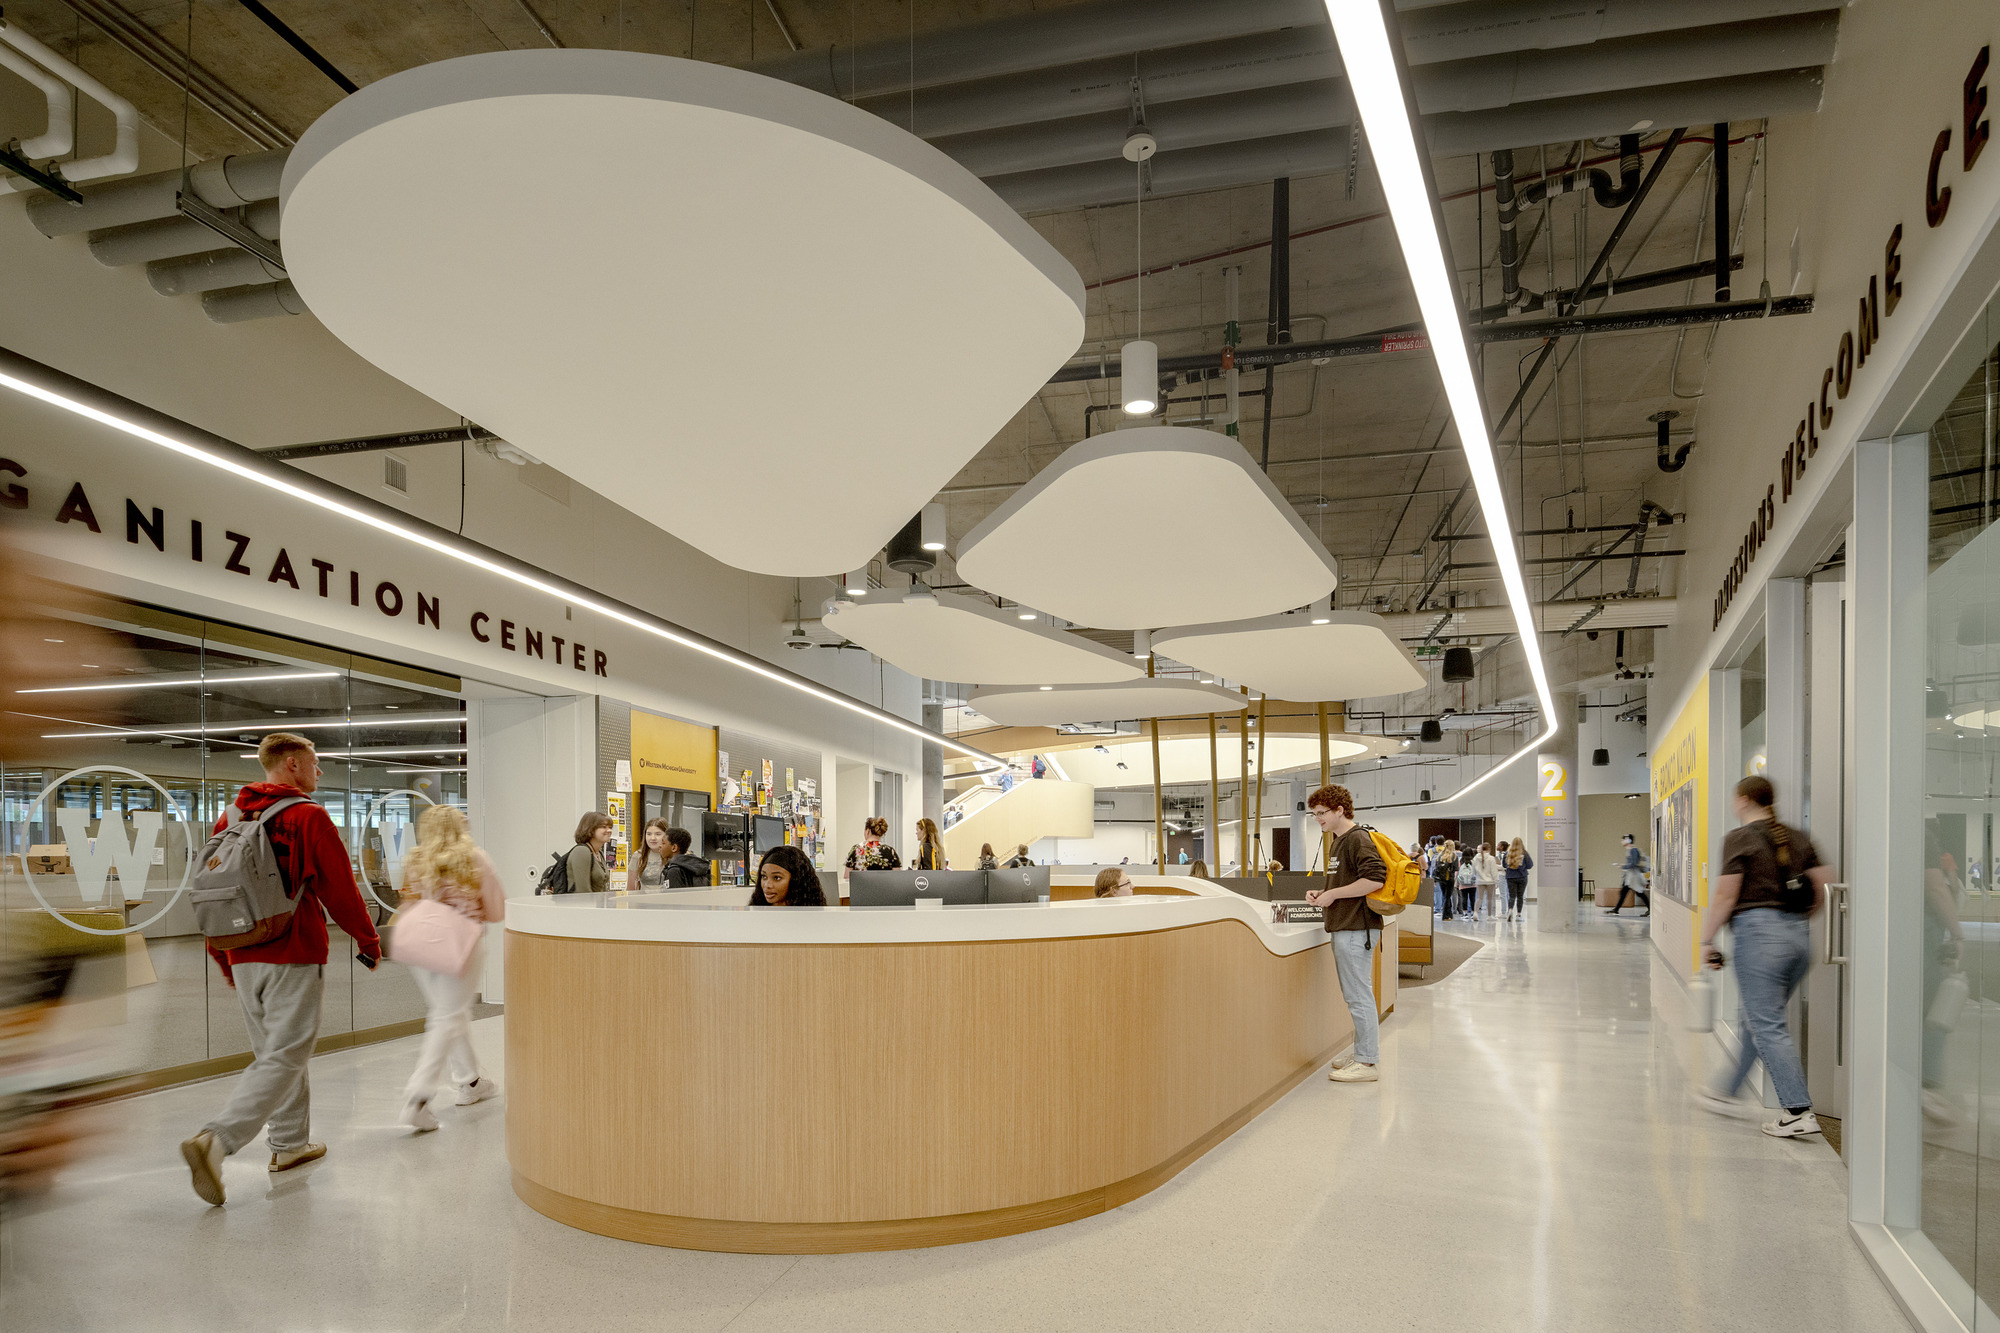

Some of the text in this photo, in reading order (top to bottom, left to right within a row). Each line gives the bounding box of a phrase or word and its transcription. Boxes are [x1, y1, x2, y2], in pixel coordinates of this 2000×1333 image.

[1712, 44, 1991, 632] ADMISSIONS WELCOME CE
[0, 457, 607, 678] GANIZATION CENTER
[1540, 762, 1567, 801] 2
[1676, 726, 1697, 785] NATION
[56, 807, 163, 902] W
